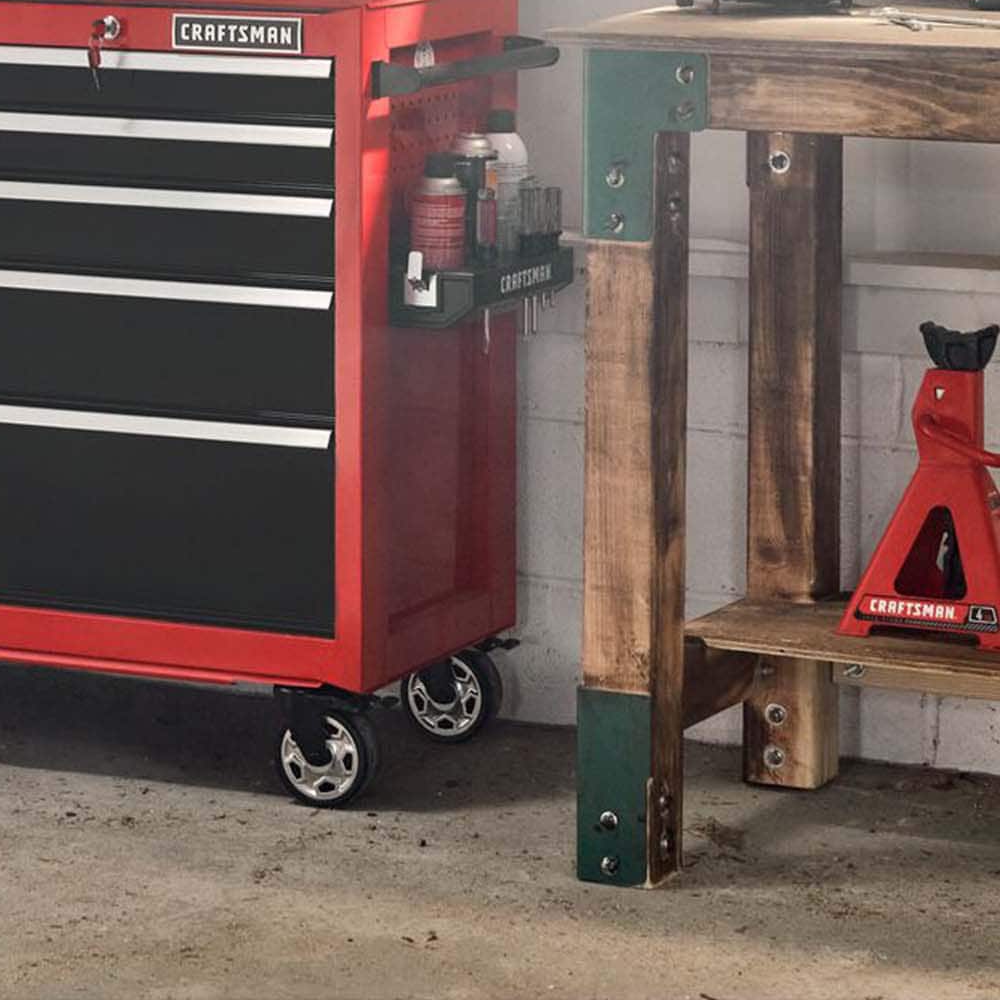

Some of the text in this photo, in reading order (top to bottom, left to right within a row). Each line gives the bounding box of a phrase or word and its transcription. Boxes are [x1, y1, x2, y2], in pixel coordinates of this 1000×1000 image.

[180, 23, 292, 44] CRAFTSMAN
[500, 264, 552, 294] CRAFTSMAN
[869, 599, 955, 619] CRAFTSMAN
